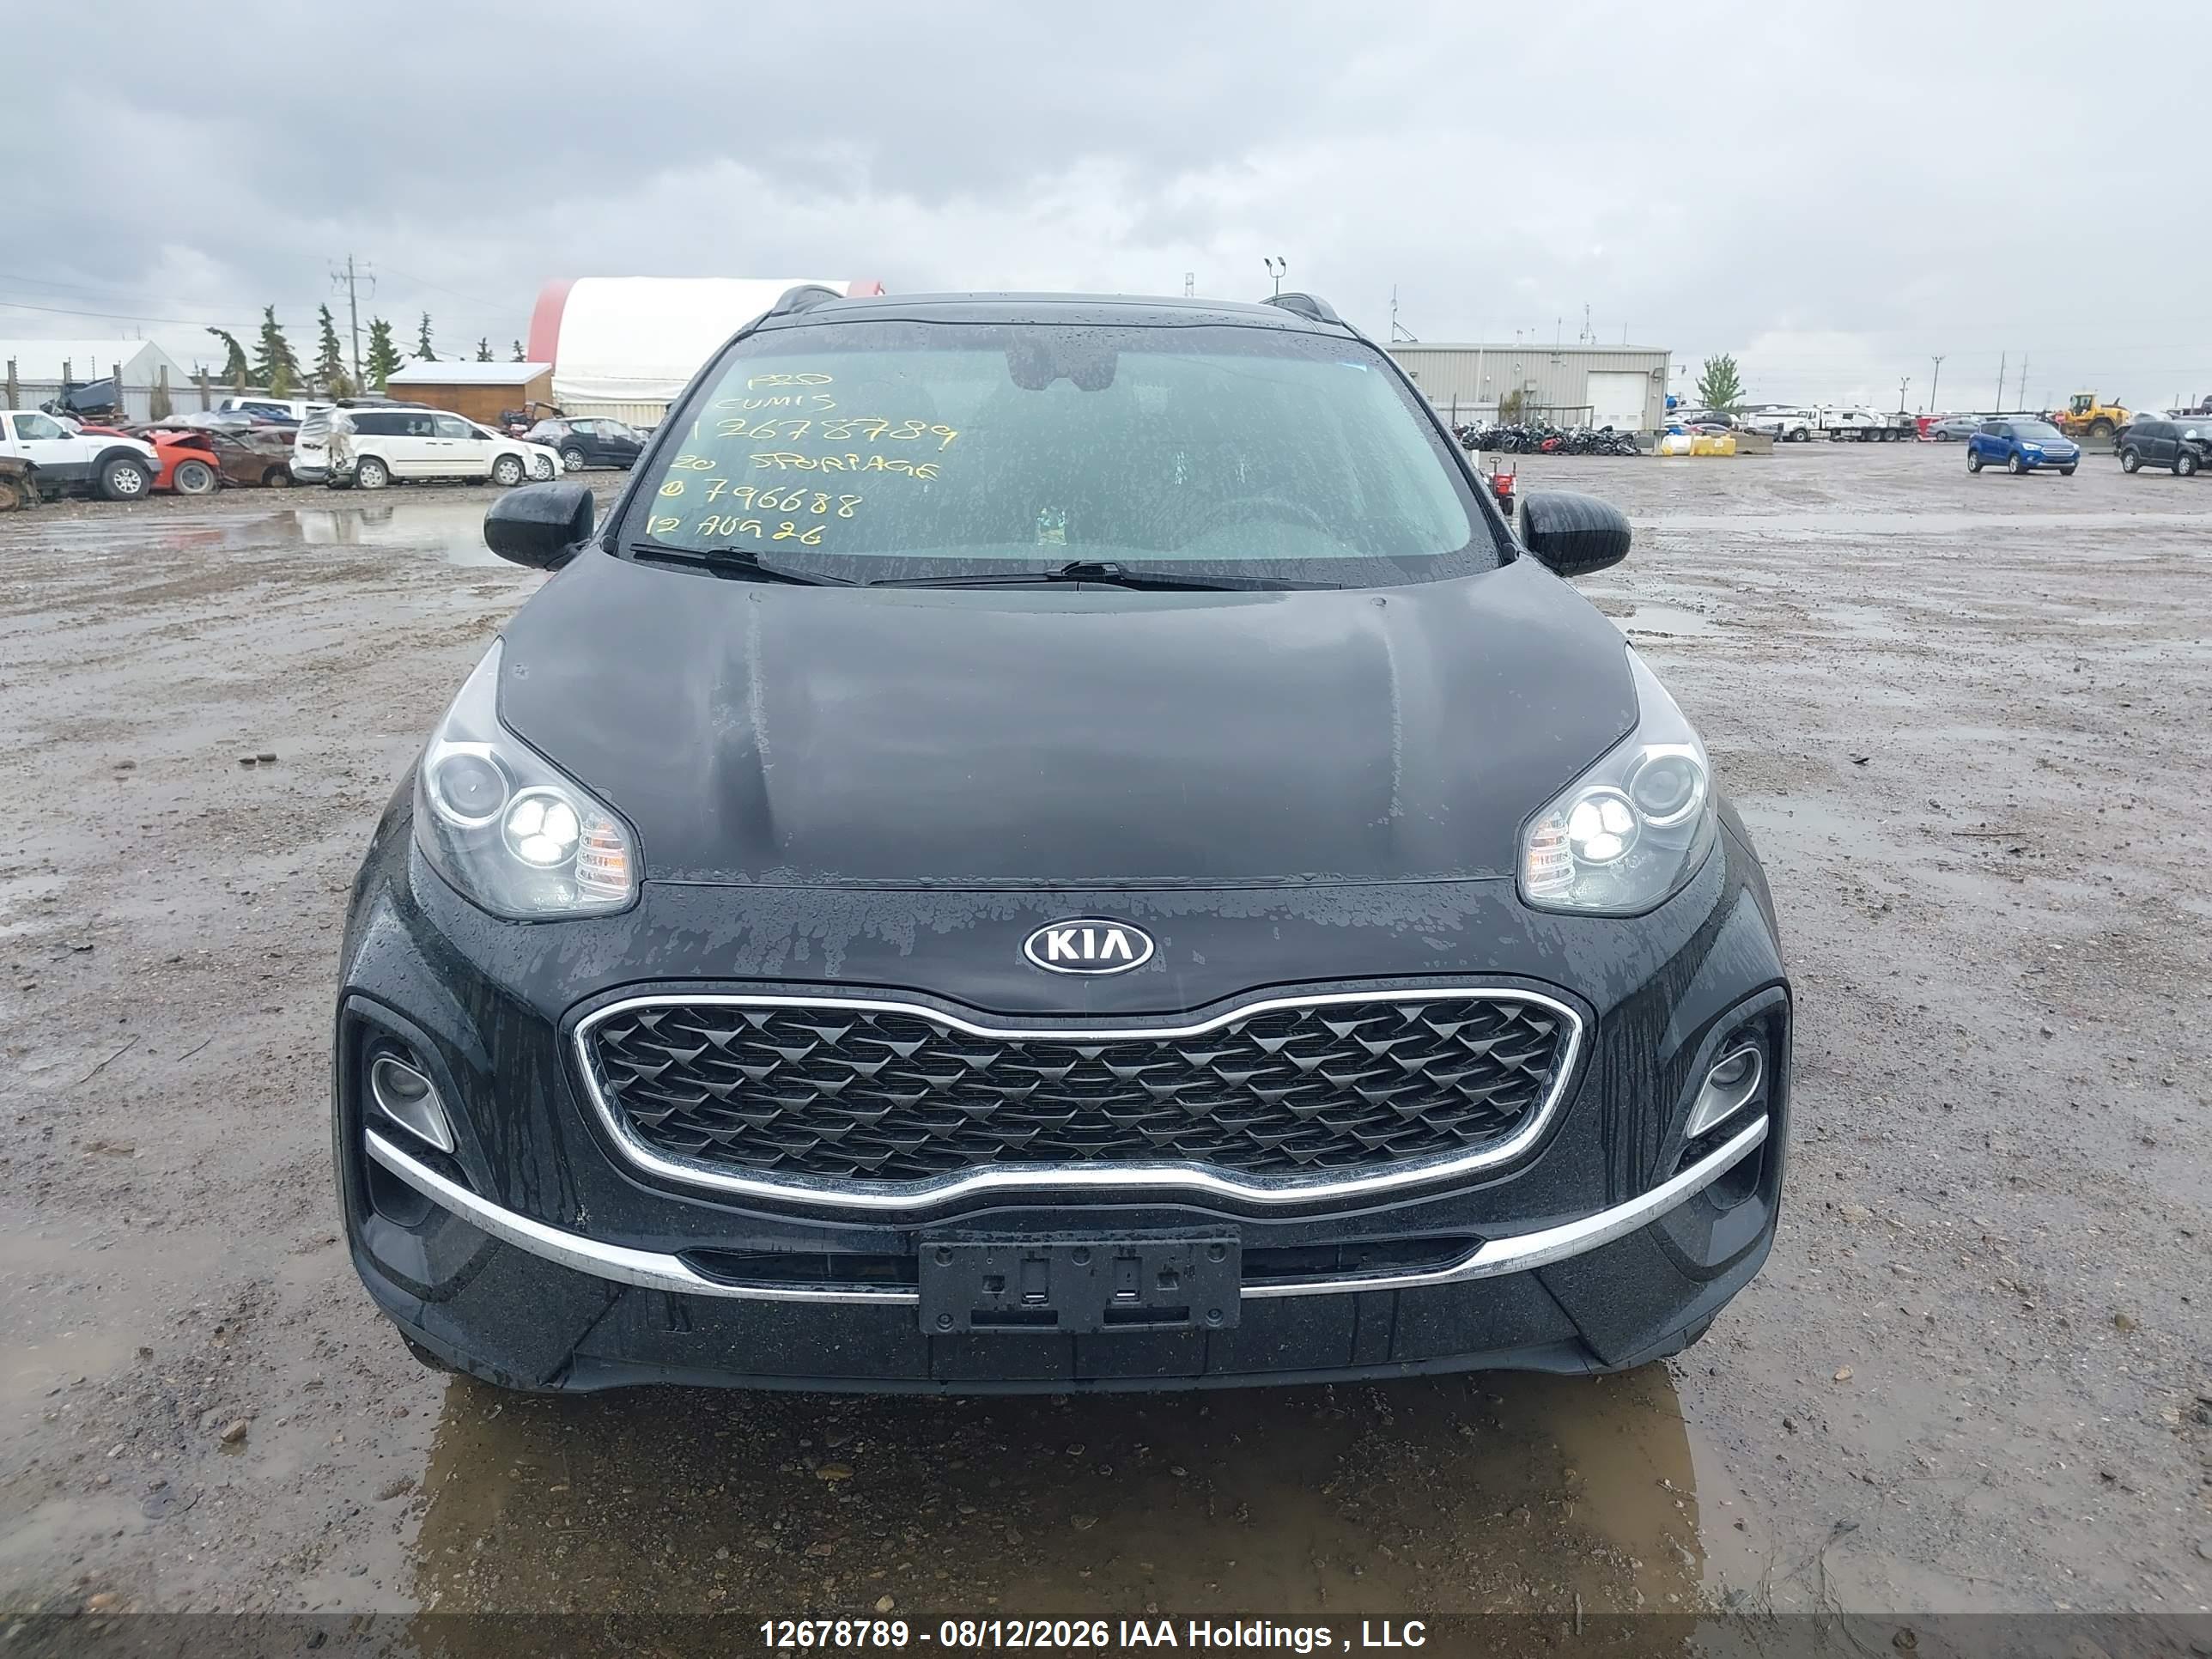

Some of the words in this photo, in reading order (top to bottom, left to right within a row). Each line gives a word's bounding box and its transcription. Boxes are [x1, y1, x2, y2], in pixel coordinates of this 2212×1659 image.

[714, 393, 837, 413] CUMIS
[694, 418, 958, 453] 12678789
[671, 454, 716, 471] 20
[645, 515, 680, 536] 12
[695, 515, 763, 539] AUG
[772, 520, 827, 545] 26
[1046, 928, 1133, 961] KIA
